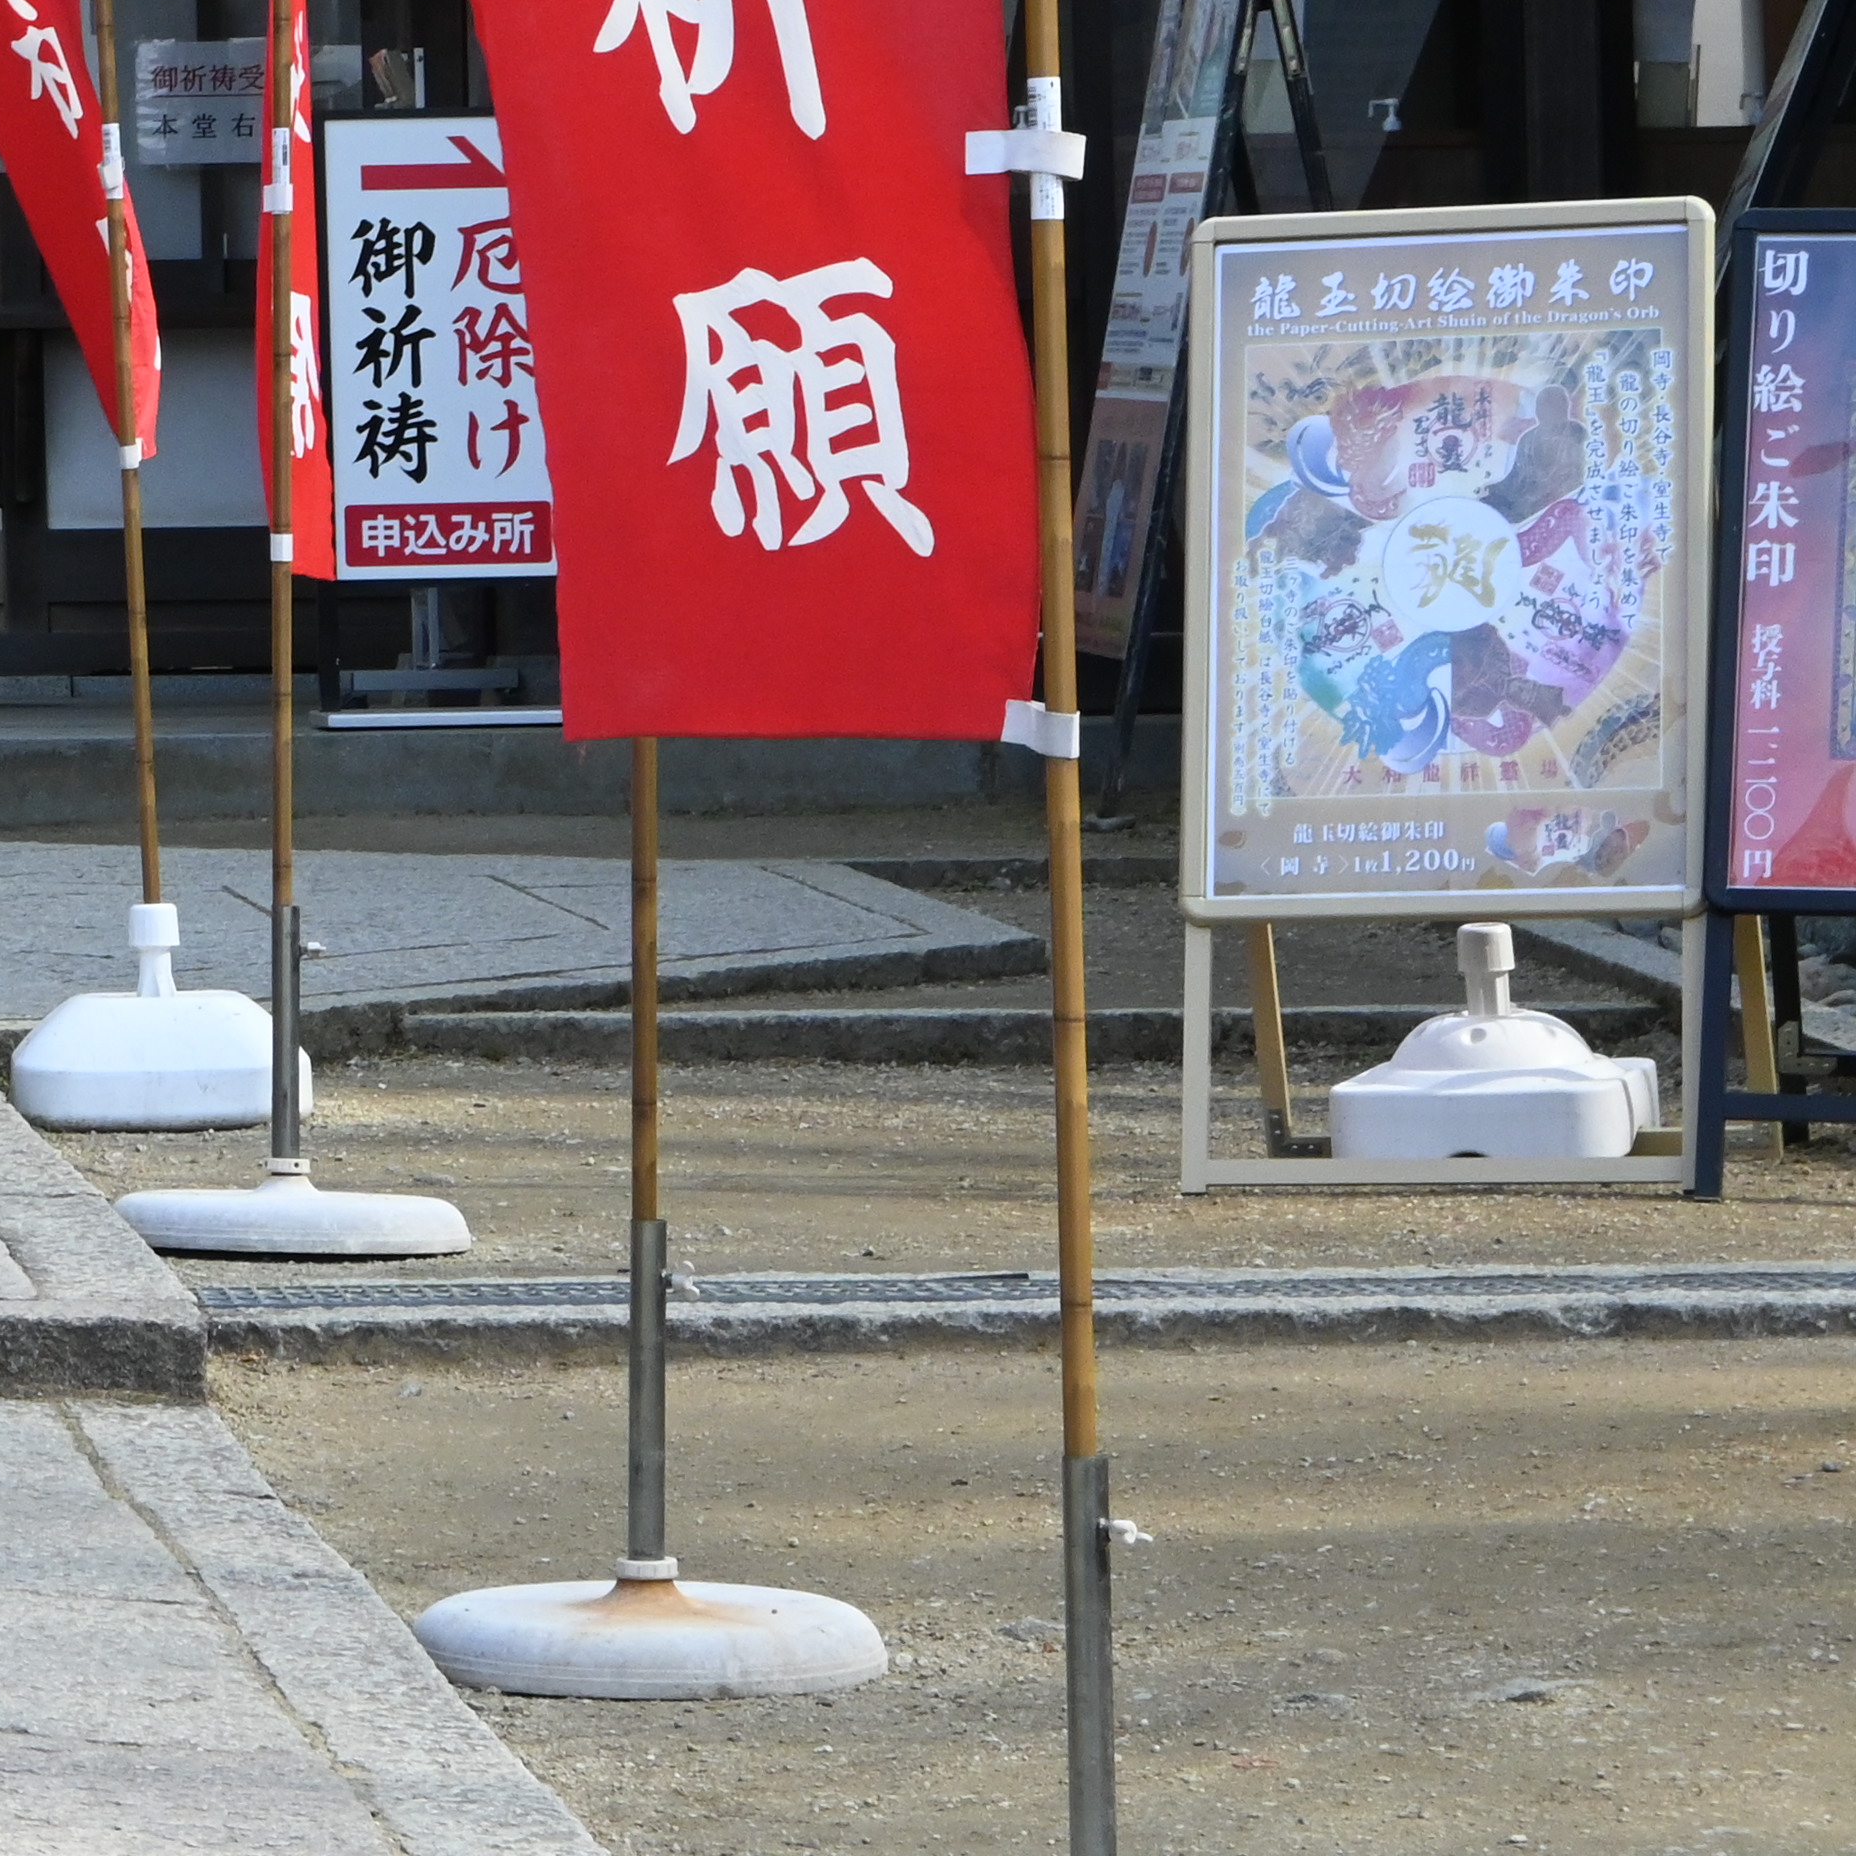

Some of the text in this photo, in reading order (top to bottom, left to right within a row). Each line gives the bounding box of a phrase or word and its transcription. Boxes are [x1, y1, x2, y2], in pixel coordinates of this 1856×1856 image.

[151, 64, 264, 93] 御祈祷受
[152, 112, 256, 141] 本堂右
[1250, 257, 1655, 321] 龍玉切絵御朱印
[451, 216, 536, 479] 厄除け
[1247, 305, 1660, 337] the Paper-Cutting-Art Shuin of the Dragon's Orb
[348, 217, 438, 484] 御祈祷
[1744, 248, 1809, 587] 切り絵ご朱印
[1618, 372, 1640, 628] 龍の切り絵ご朱印を集めて
[361, 510, 536, 557] 申込み所
[1293, 820, 1445, 845] 龍玉切絵御朱印
